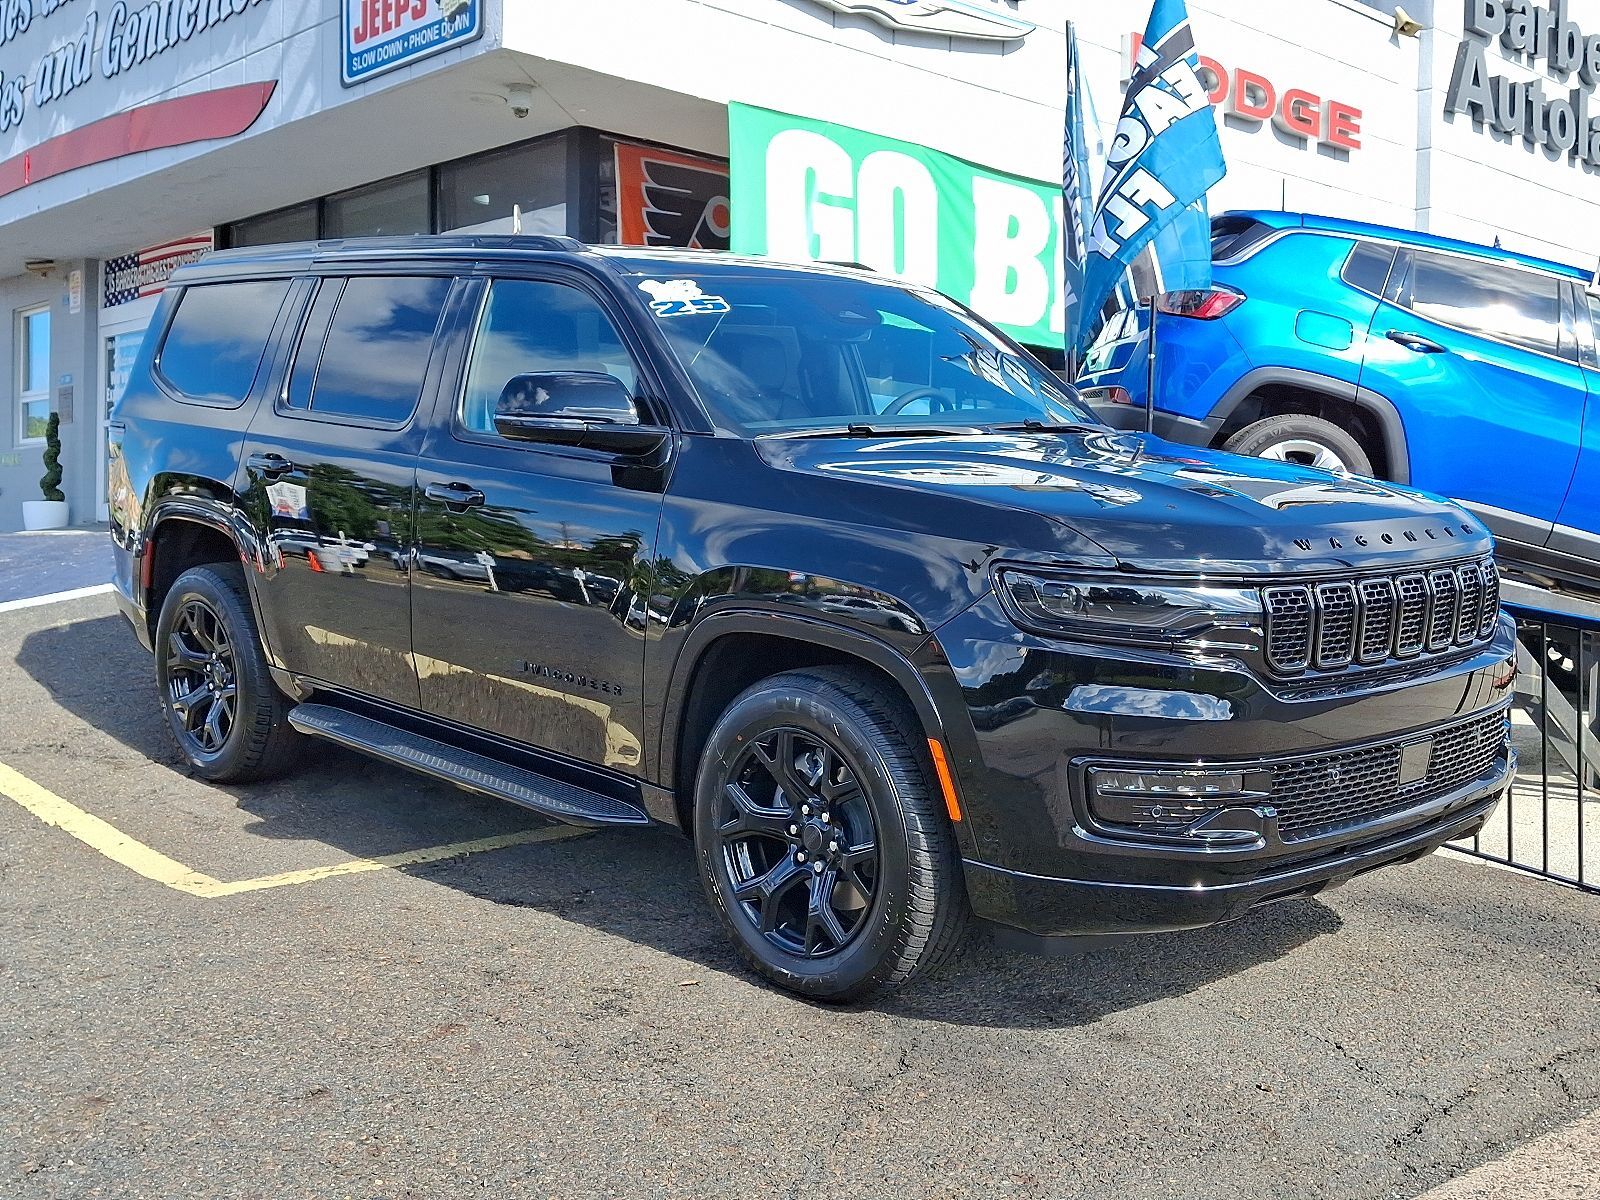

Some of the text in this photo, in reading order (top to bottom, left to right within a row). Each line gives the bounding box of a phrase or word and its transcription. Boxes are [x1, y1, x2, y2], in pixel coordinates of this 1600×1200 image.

[34, 10, 99, 108] and
[101, 0, 268, 80] Gentlem
[352, 52, 376, 71] SLOW
[377, 40, 403, 61] DOWN
[409, 25, 440, 50] PHONE
[1131, 31, 1363, 150] ODGE
[765, 128, 939, 288] GO
[970, 174, 1065, 333] B
[1293, 524, 1473, 552] WAGONEER
[524, 662, 622, 696] WAGONEER
